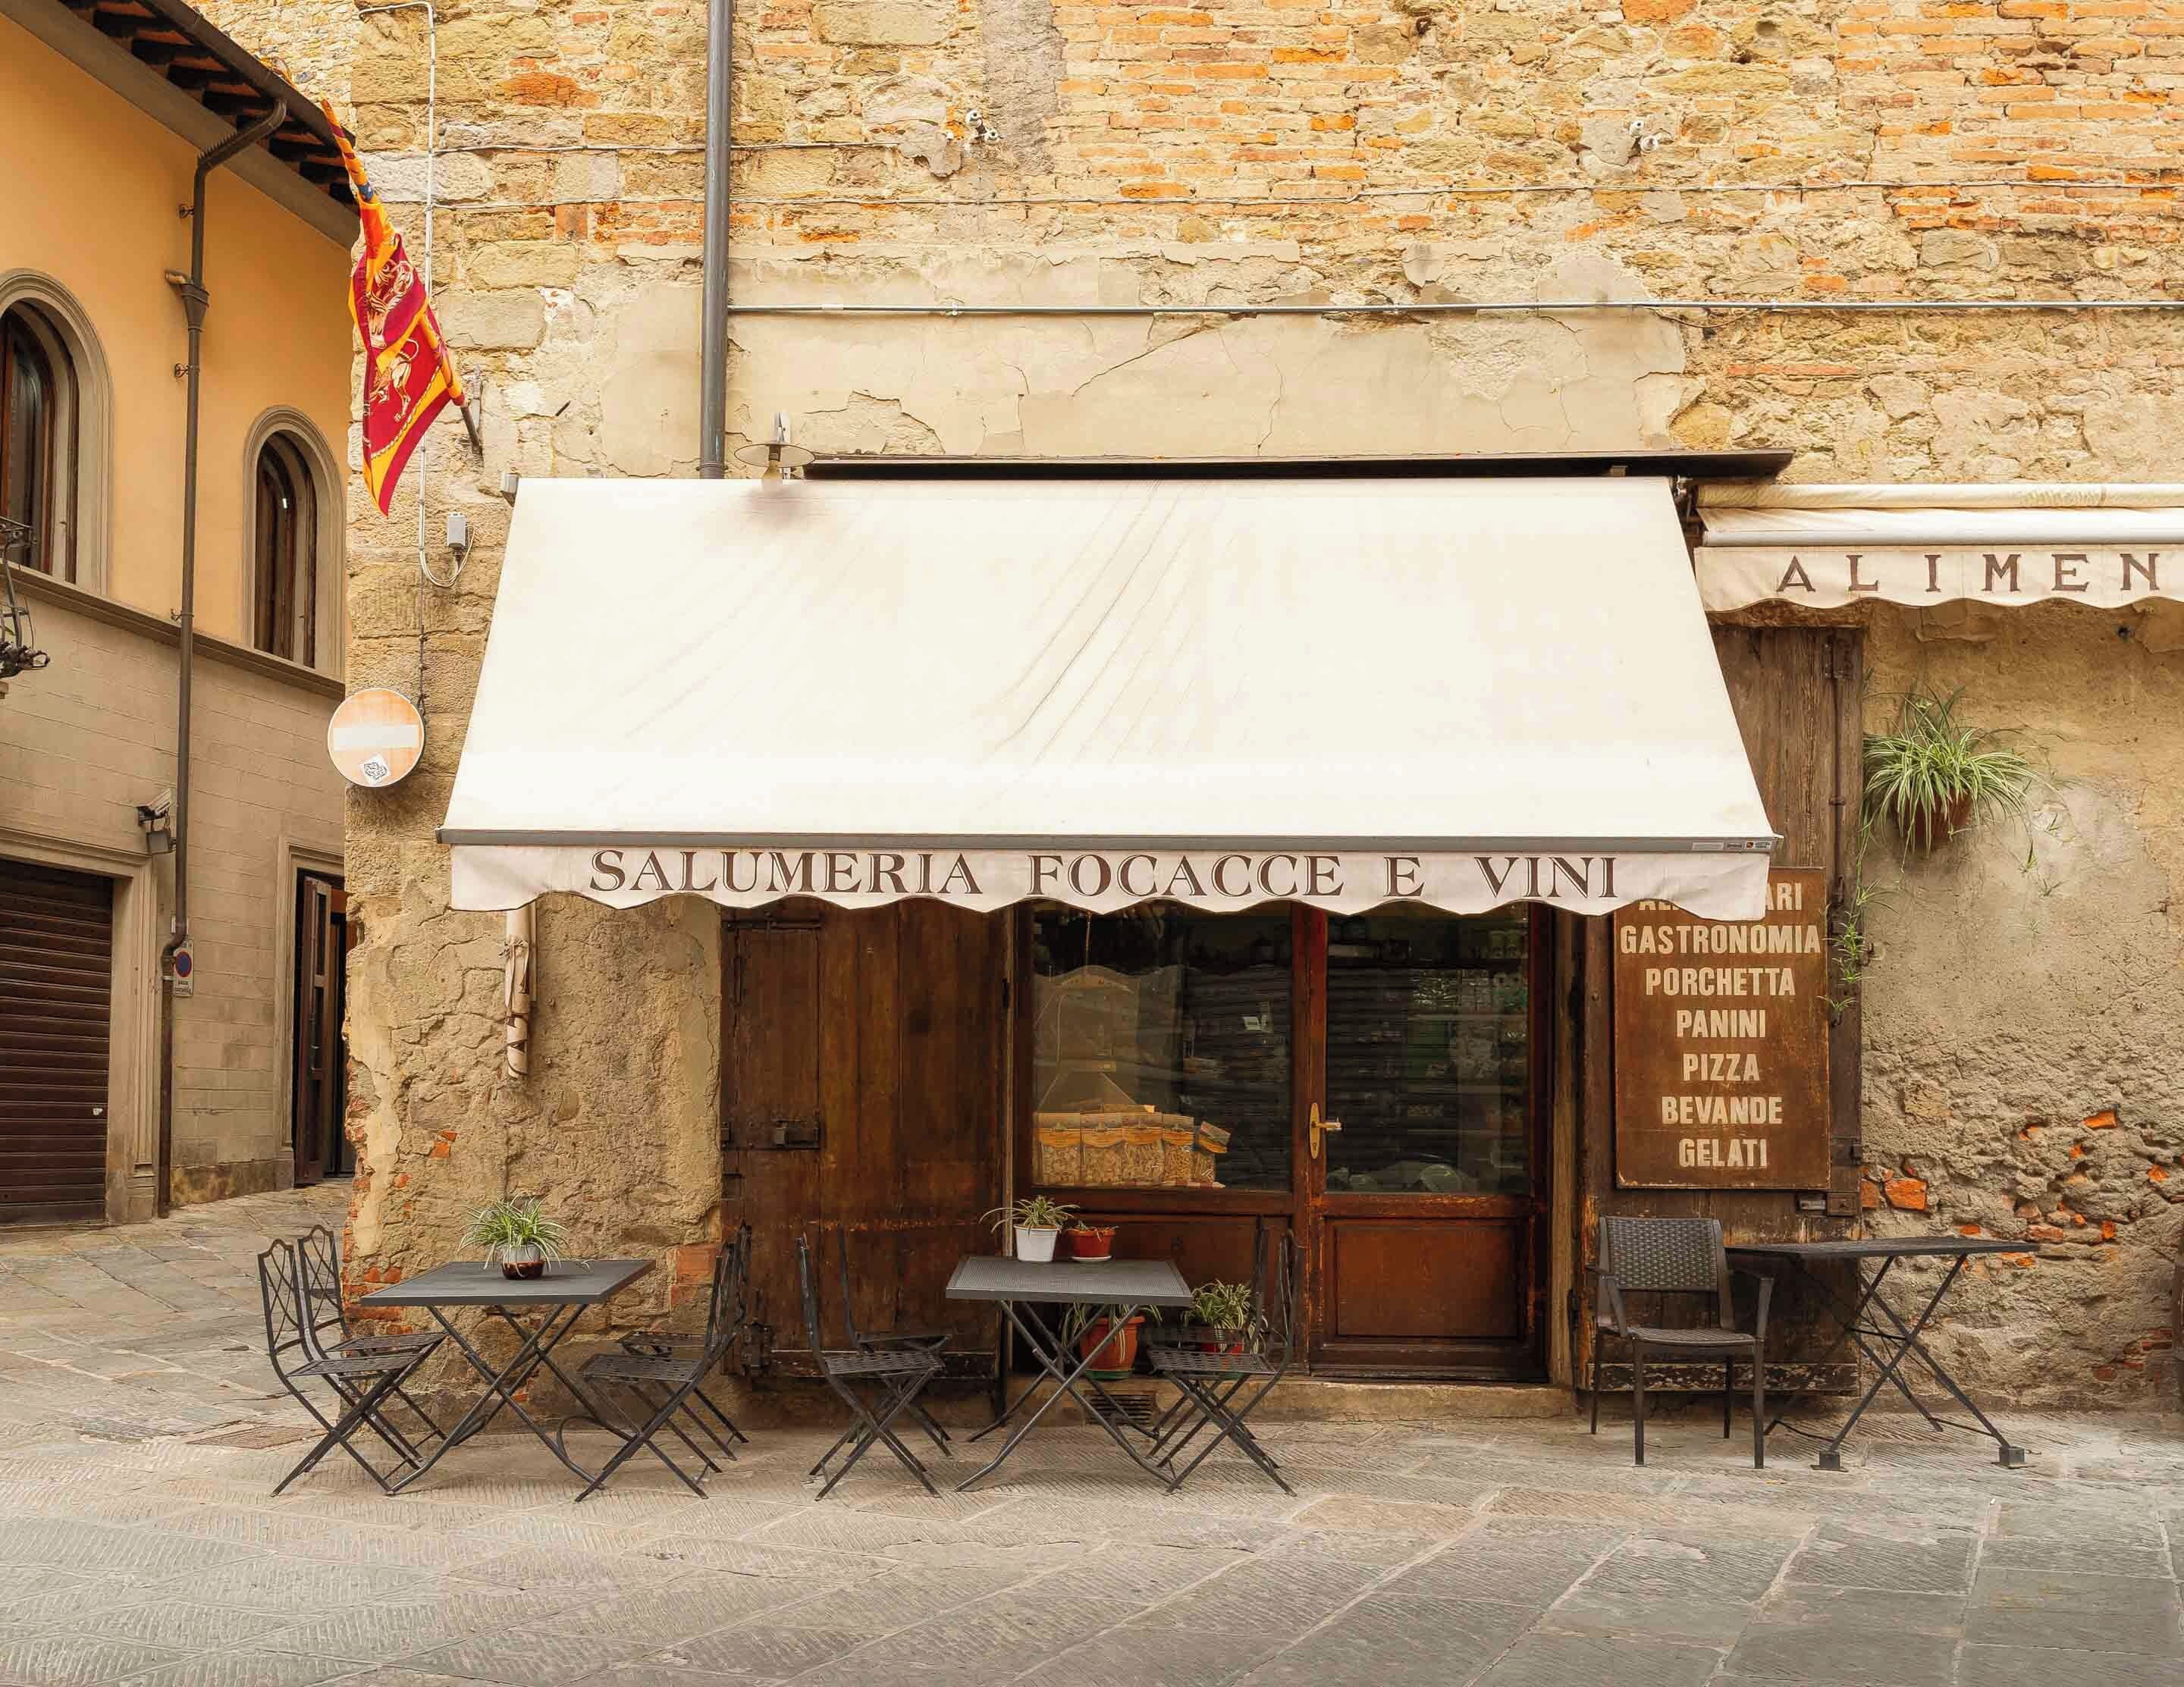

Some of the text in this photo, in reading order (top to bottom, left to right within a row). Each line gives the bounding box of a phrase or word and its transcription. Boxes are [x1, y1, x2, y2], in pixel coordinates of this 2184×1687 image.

[1776, 553, 2160, 593] ALIMEN
[589, 849, 983, 895] SALUMERIA
[1027, 854, 1344, 898] FOCACCE
[1383, 856, 1425, 898] E
[1473, 856, 1619, 899] VINI
[1620, 924, 1821, 954] GASTRONOMIA
[1645, 967, 1796, 996] PORCHETTA
[1676, 1009, 1766, 1039] PANINI
[1683, 1052, 1759, 1082] PIZZA
[1662, 1096, 1783, 1125] BEVANDE
[1678, 1138, 1768, 1170] GELATI
